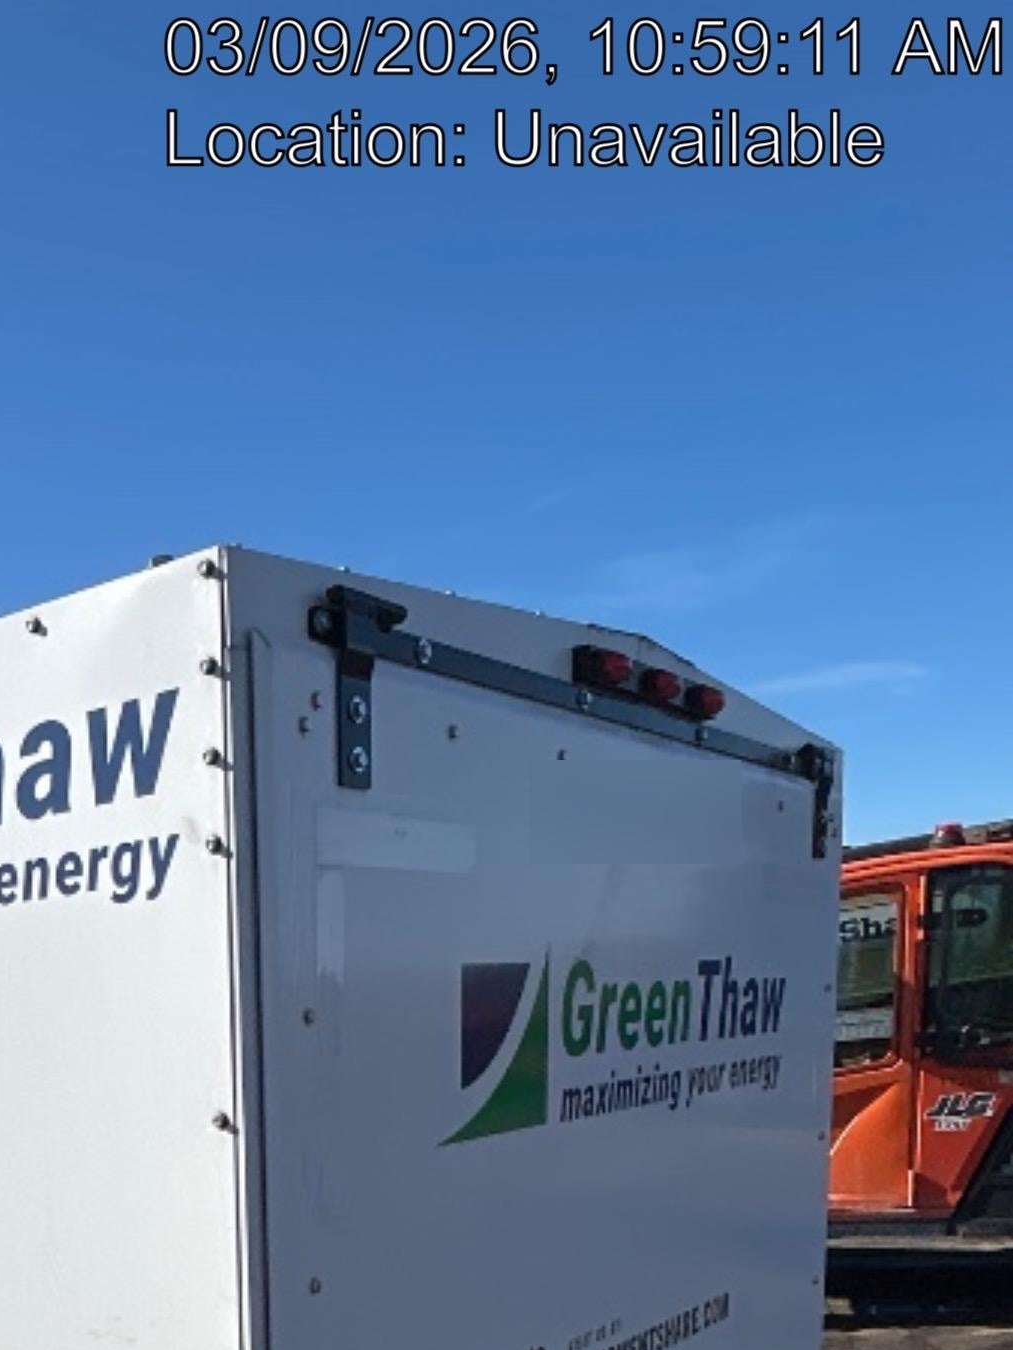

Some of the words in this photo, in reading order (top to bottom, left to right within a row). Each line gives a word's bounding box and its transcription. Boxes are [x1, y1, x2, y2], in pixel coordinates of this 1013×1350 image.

[559, 1063, 682, 1123] maximizing
[687, 1058, 725, 1107] your
[729, 1054, 781, 1091] energy
